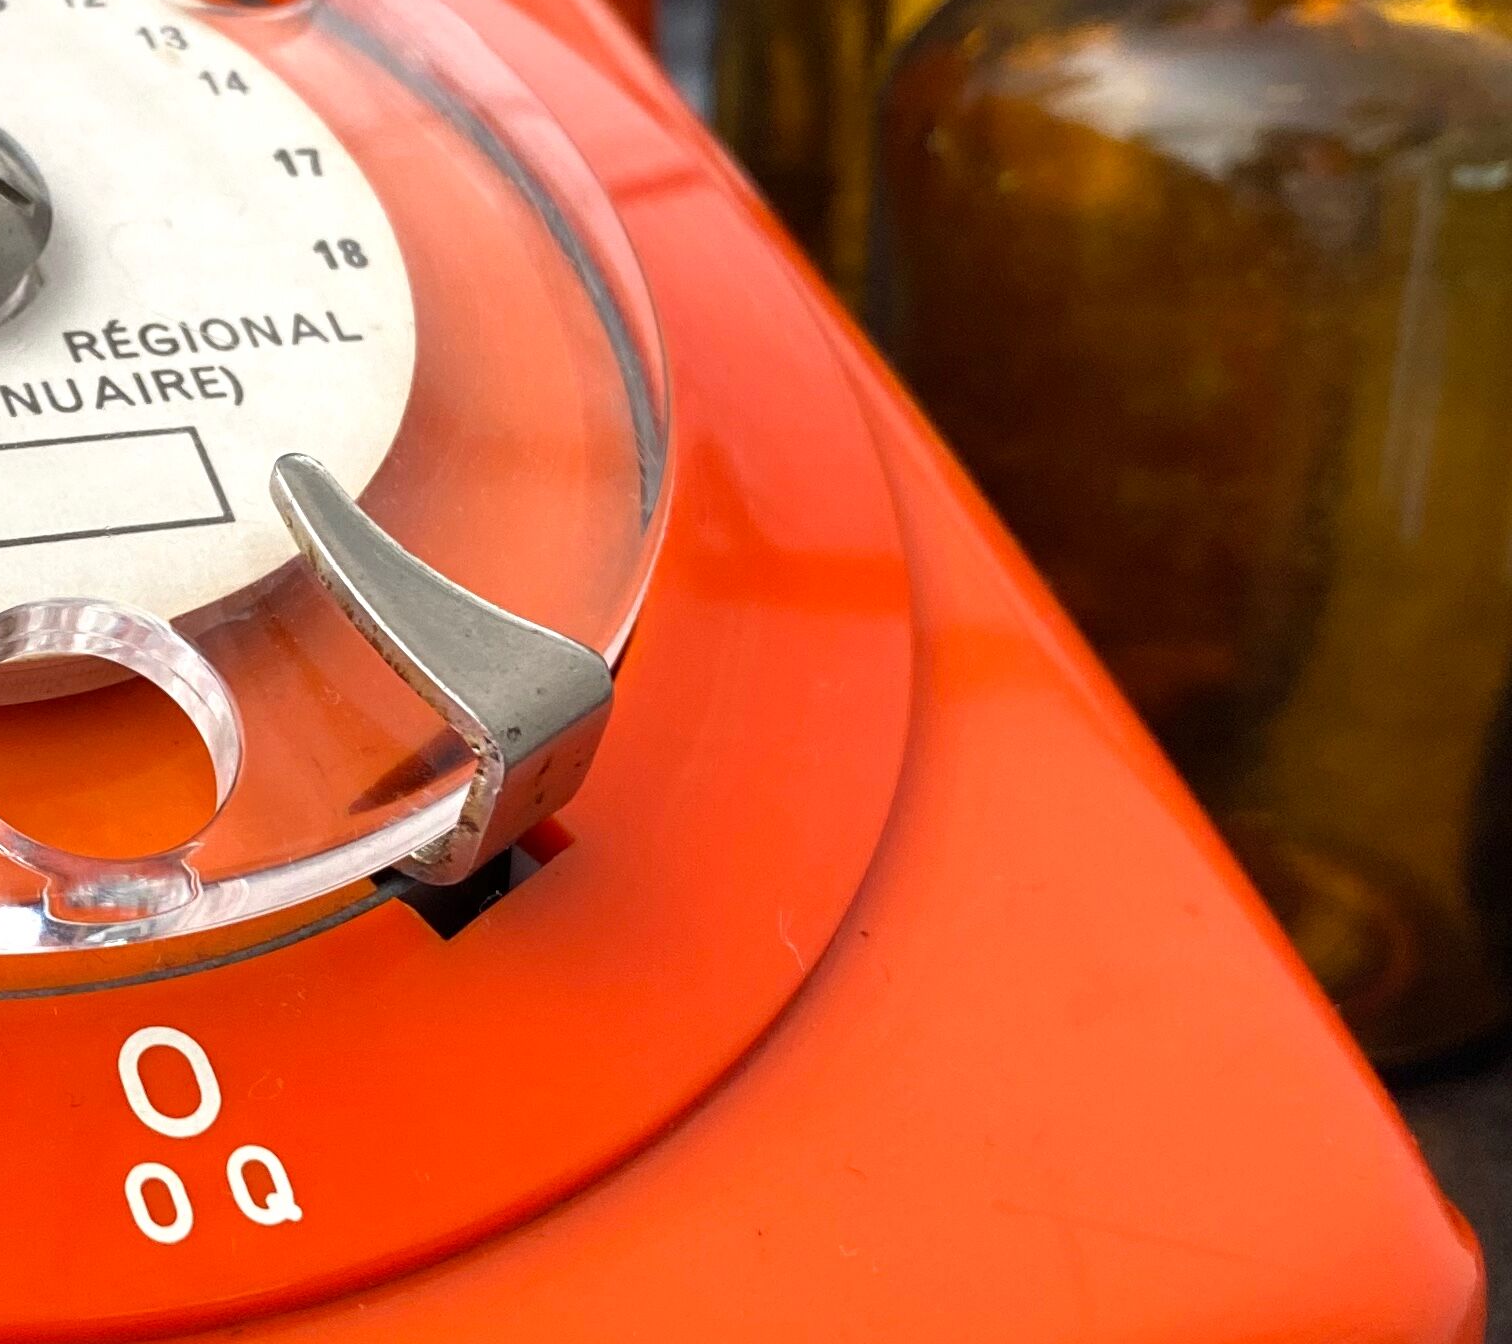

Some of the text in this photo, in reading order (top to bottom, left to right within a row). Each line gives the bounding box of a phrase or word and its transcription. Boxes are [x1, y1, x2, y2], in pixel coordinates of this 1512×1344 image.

[136, 25, 189, 51] 13
[198, 69, 250, 96] 14
[272, 147, 324, 178] 17
[312, 237, 370, 271] 18
[61, 310, 365, 364] RÉGIONAL
